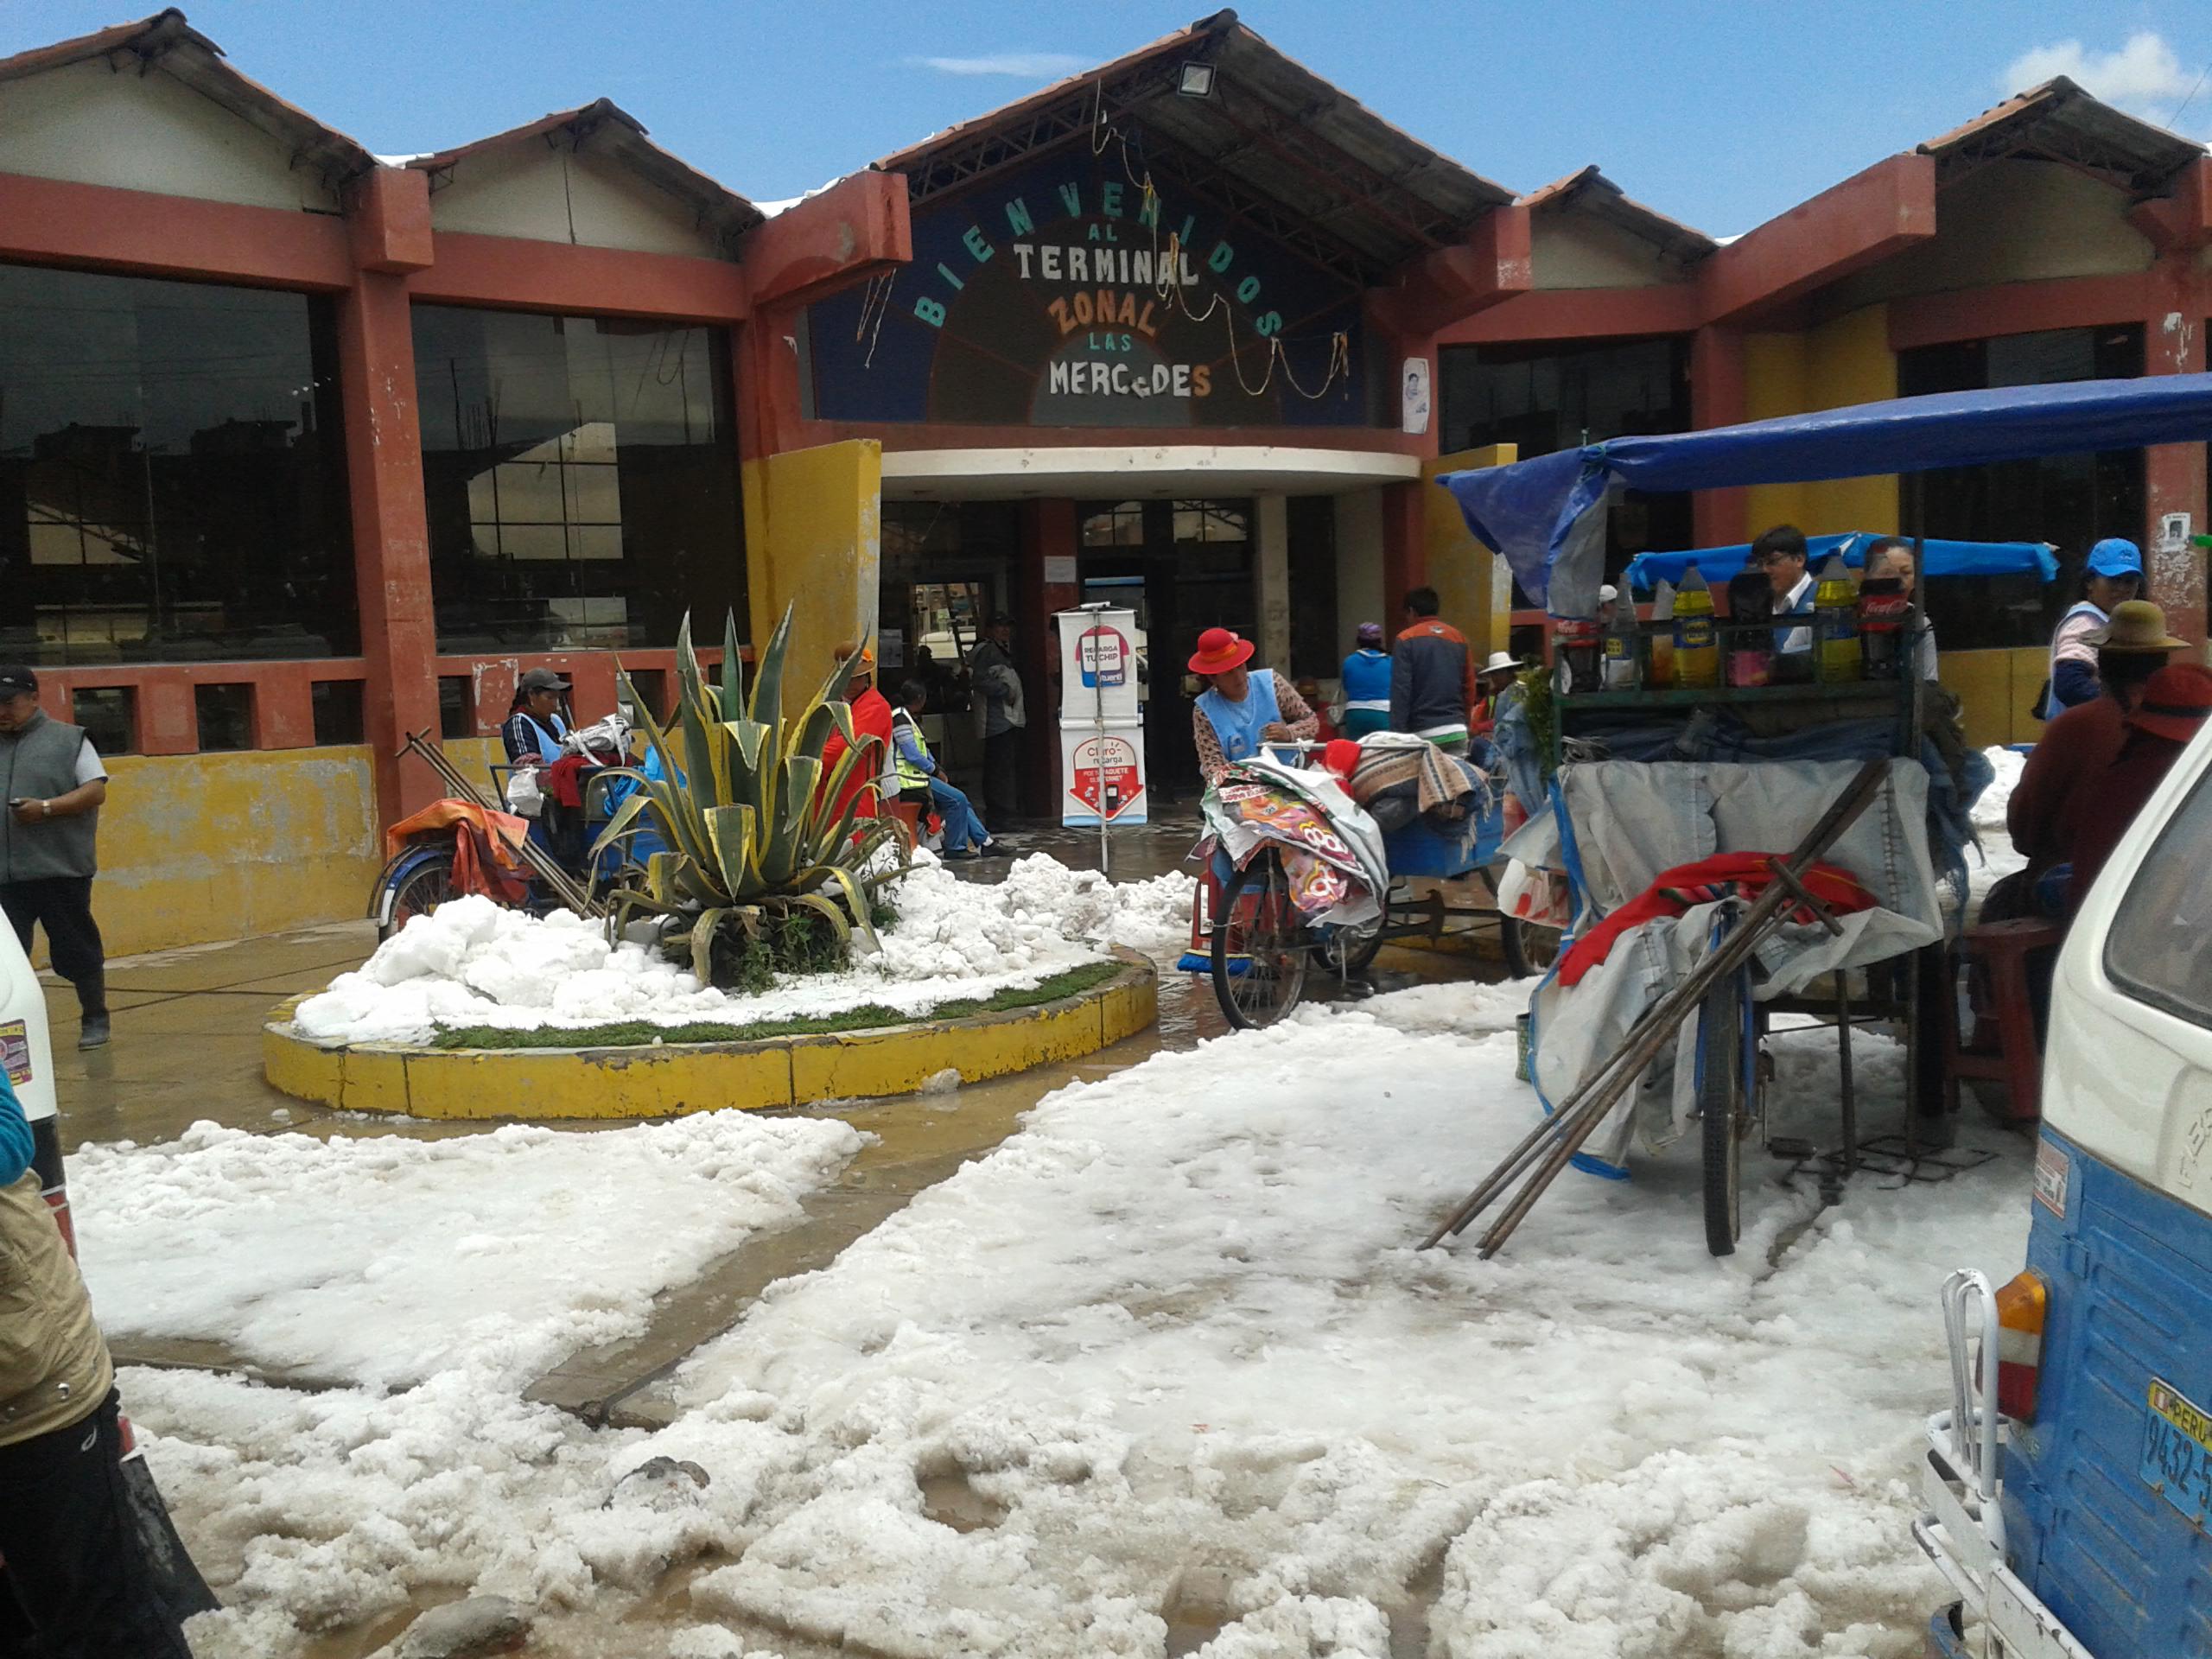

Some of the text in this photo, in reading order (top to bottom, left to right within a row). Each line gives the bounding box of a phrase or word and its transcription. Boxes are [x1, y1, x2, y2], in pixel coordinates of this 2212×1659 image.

[1088, 224, 1118, 242] AL
[1014, 244, 1199, 286] TERMINAL
[1047, 289, 1158, 337] ZONAL
[1089, 333, 1132, 352] LAS
[2171, 1402, 2207, 1443] PERU
